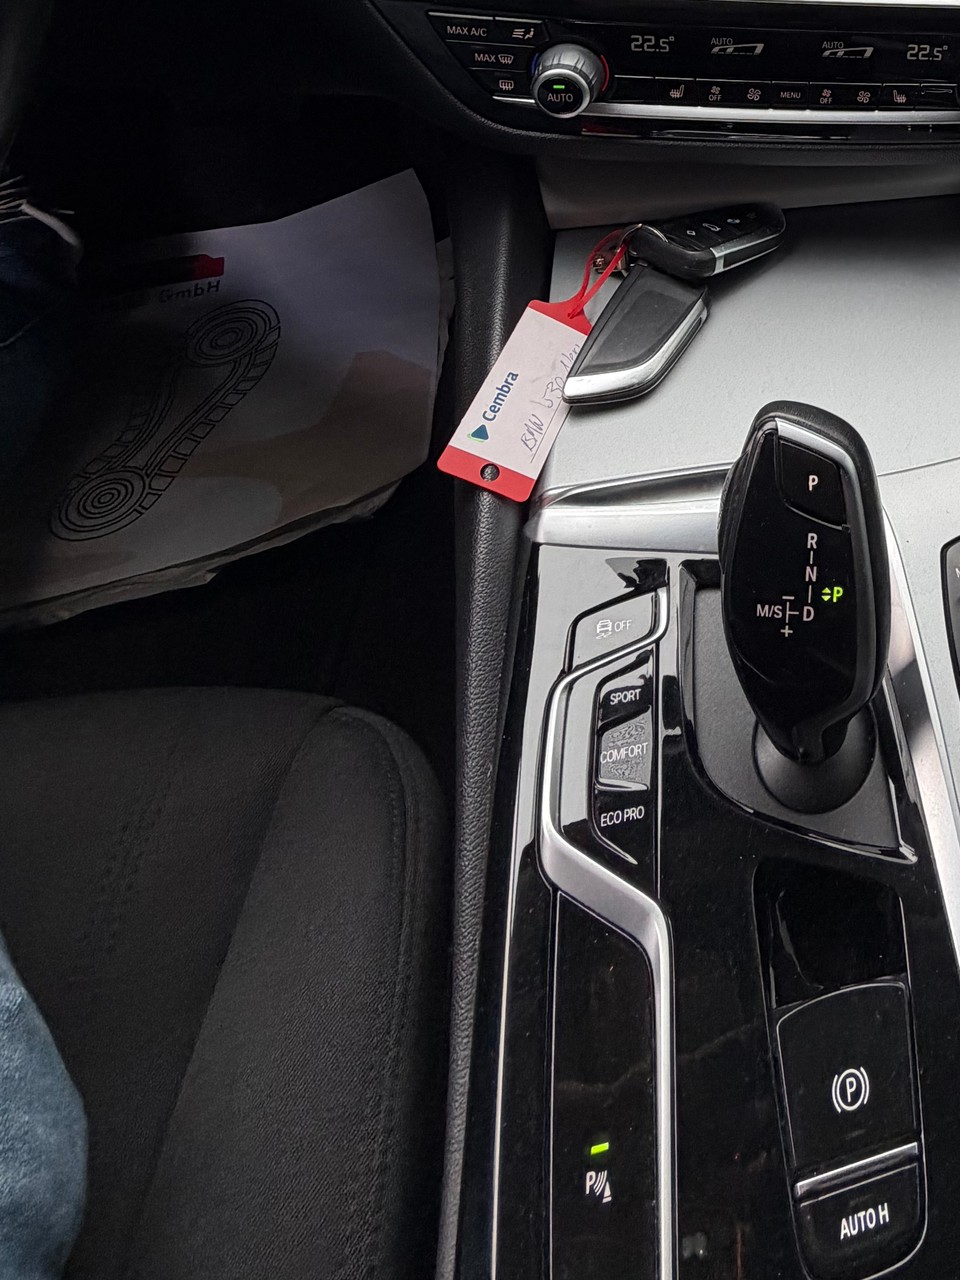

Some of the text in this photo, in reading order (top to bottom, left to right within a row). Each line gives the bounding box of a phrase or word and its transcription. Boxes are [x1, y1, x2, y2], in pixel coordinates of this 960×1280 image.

[446, 25, 487, 37] MAX A/C
[710, 37, 734, 45] AUTO
[822, 41, 844, 49] AUTO
[474, 53, 496, 62] MAX
[547, 93, 573, 102] AUTO
[708, 94, 722, 102] OFF
[780, 91, 801, 99] MENU
[159, 280, 221, 302] GmbH
[482, 371, 519, 421] Cembra
[808, 474, 819, 491] P
[807, 532, 818, 549] R
[805, 565, 817, 582] N
[832, 586, 843, 603] P
[756, 603, 783, 618] M/S
[802, 606, 815, 622] D
[614, 620, 632, 633] OFF
[609, 688, 642, 705] SPORT
[600, 742, 648, 764] COMFORT
[600, 805, 645, 827] ECO PRO
[840, 1202, 889, 1240] AUTO H
